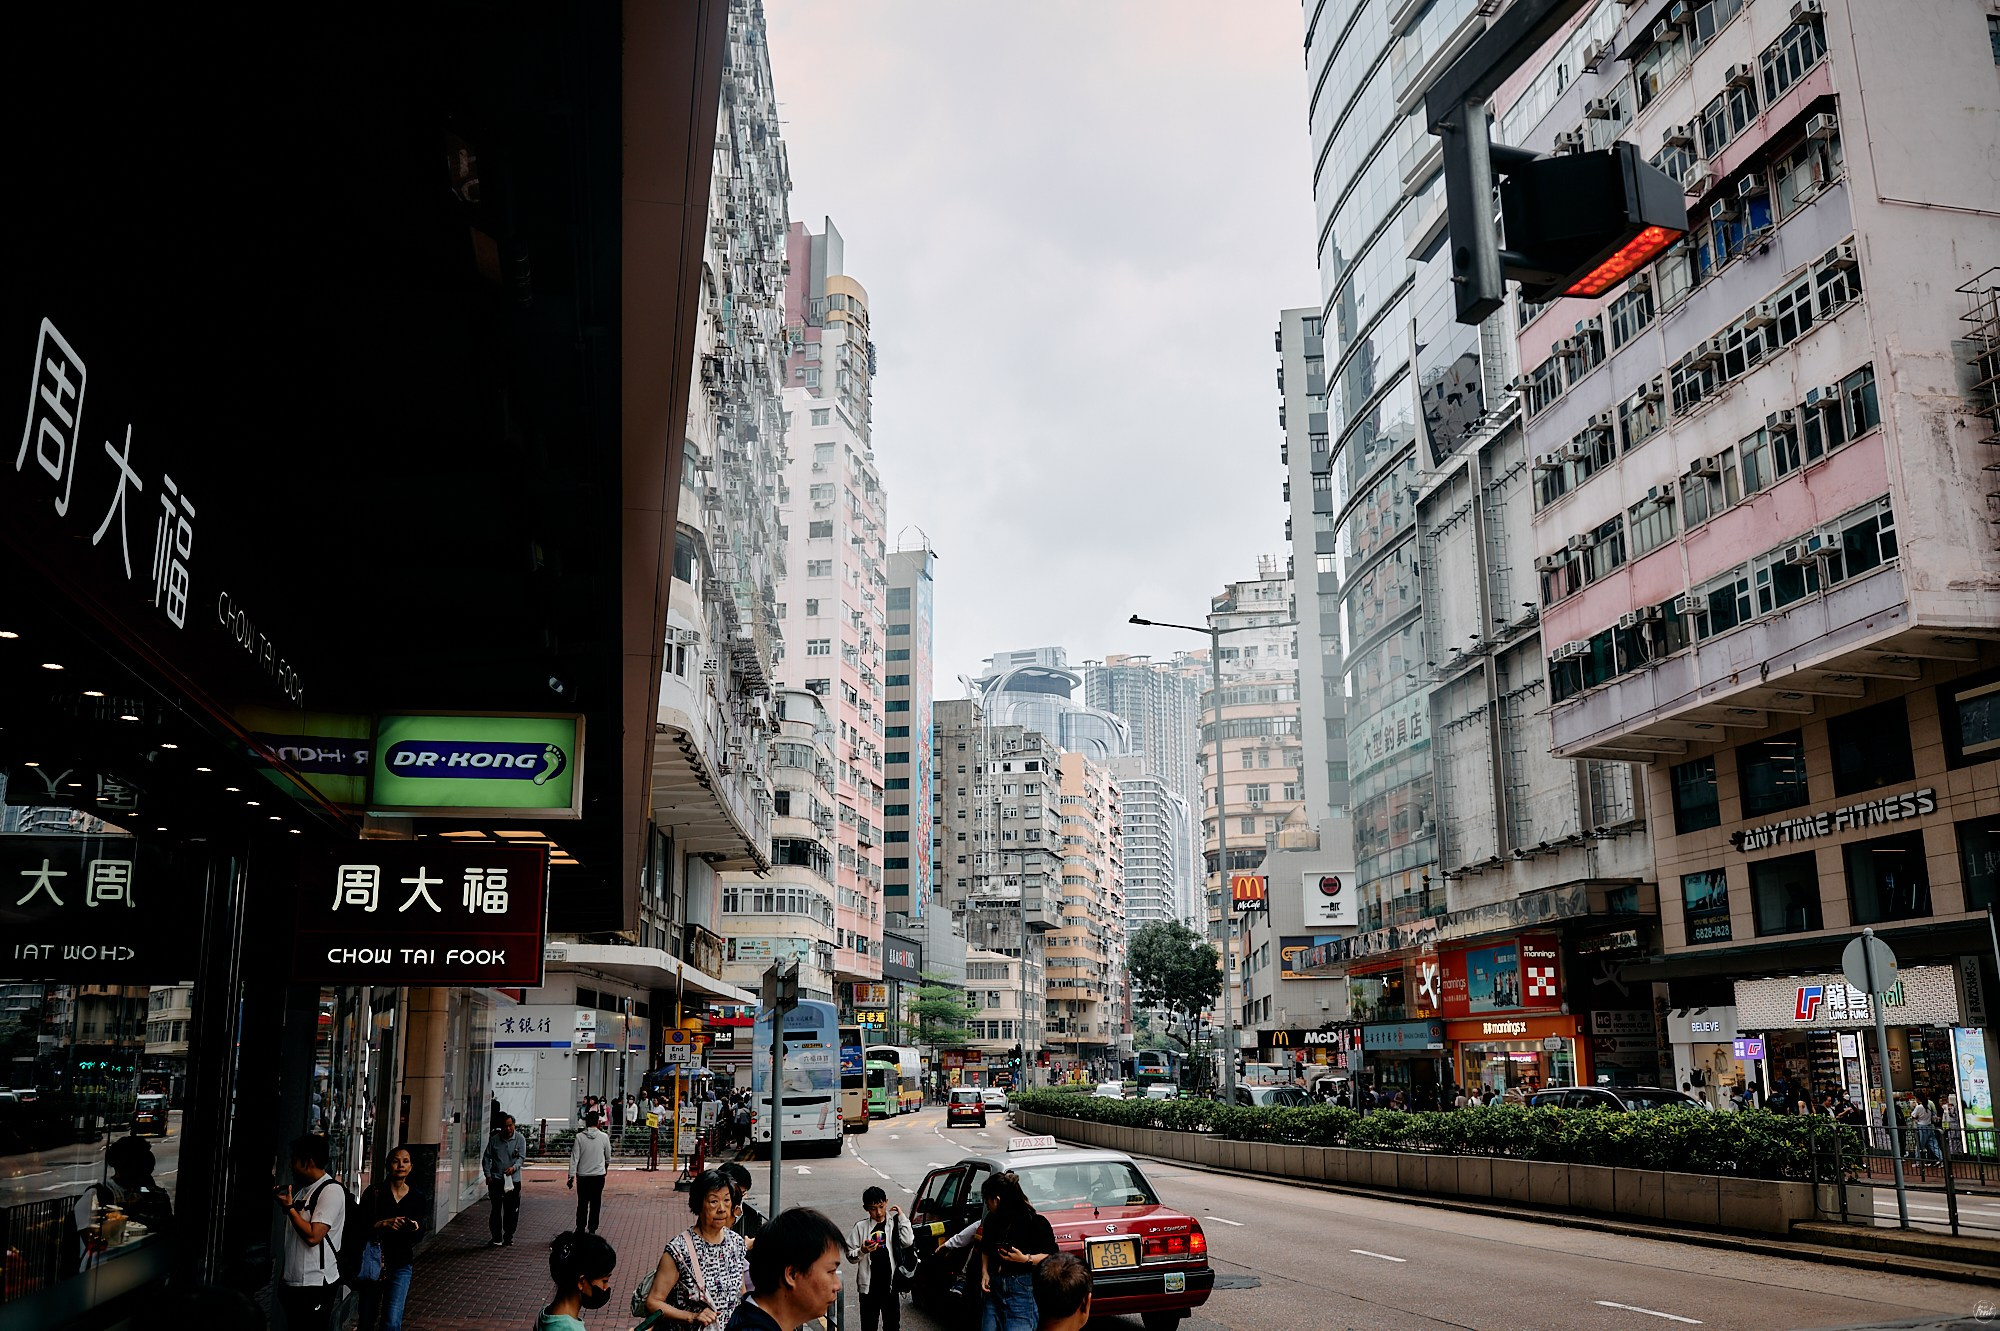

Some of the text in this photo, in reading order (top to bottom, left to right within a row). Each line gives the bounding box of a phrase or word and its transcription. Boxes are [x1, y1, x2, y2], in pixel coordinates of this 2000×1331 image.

[15, 316, 196, 630] 周大福
[218, 591, 304, 709] CHOW TAI FOOK
[1364, 711, 1423, 765] 大型釣具店
[1743, 788, 1935, 851] ANYTIME FITNESS
[332, 865, 508, 913] 周大福
[1695, 924, 1730, 940] 6828-1828
[327, 948, 506, 965] CHOW TAI FOOK
[1523, 950, 1556, 959] mannings
[857, 985, 885, 997] 明珠
[1442, 977, 1467, 991] mannings
[1597, 1016, 1610, 1025] HC
[1830, 1009, 1869, 1020] LUNG FUNG
[494, 1016, 551, 1033] 業銀行
[1492, 1020, 1520, 1036] mannings
[1691, 1021, 1720, 1032] BELIEVE
[669, 1053, 686, 1061] 終止
[1012, 1137, 1053, 1148] TAXI
[1103, 1242, 1121, 1255] KB
[1101, 1254, 1127, 1267] 693
